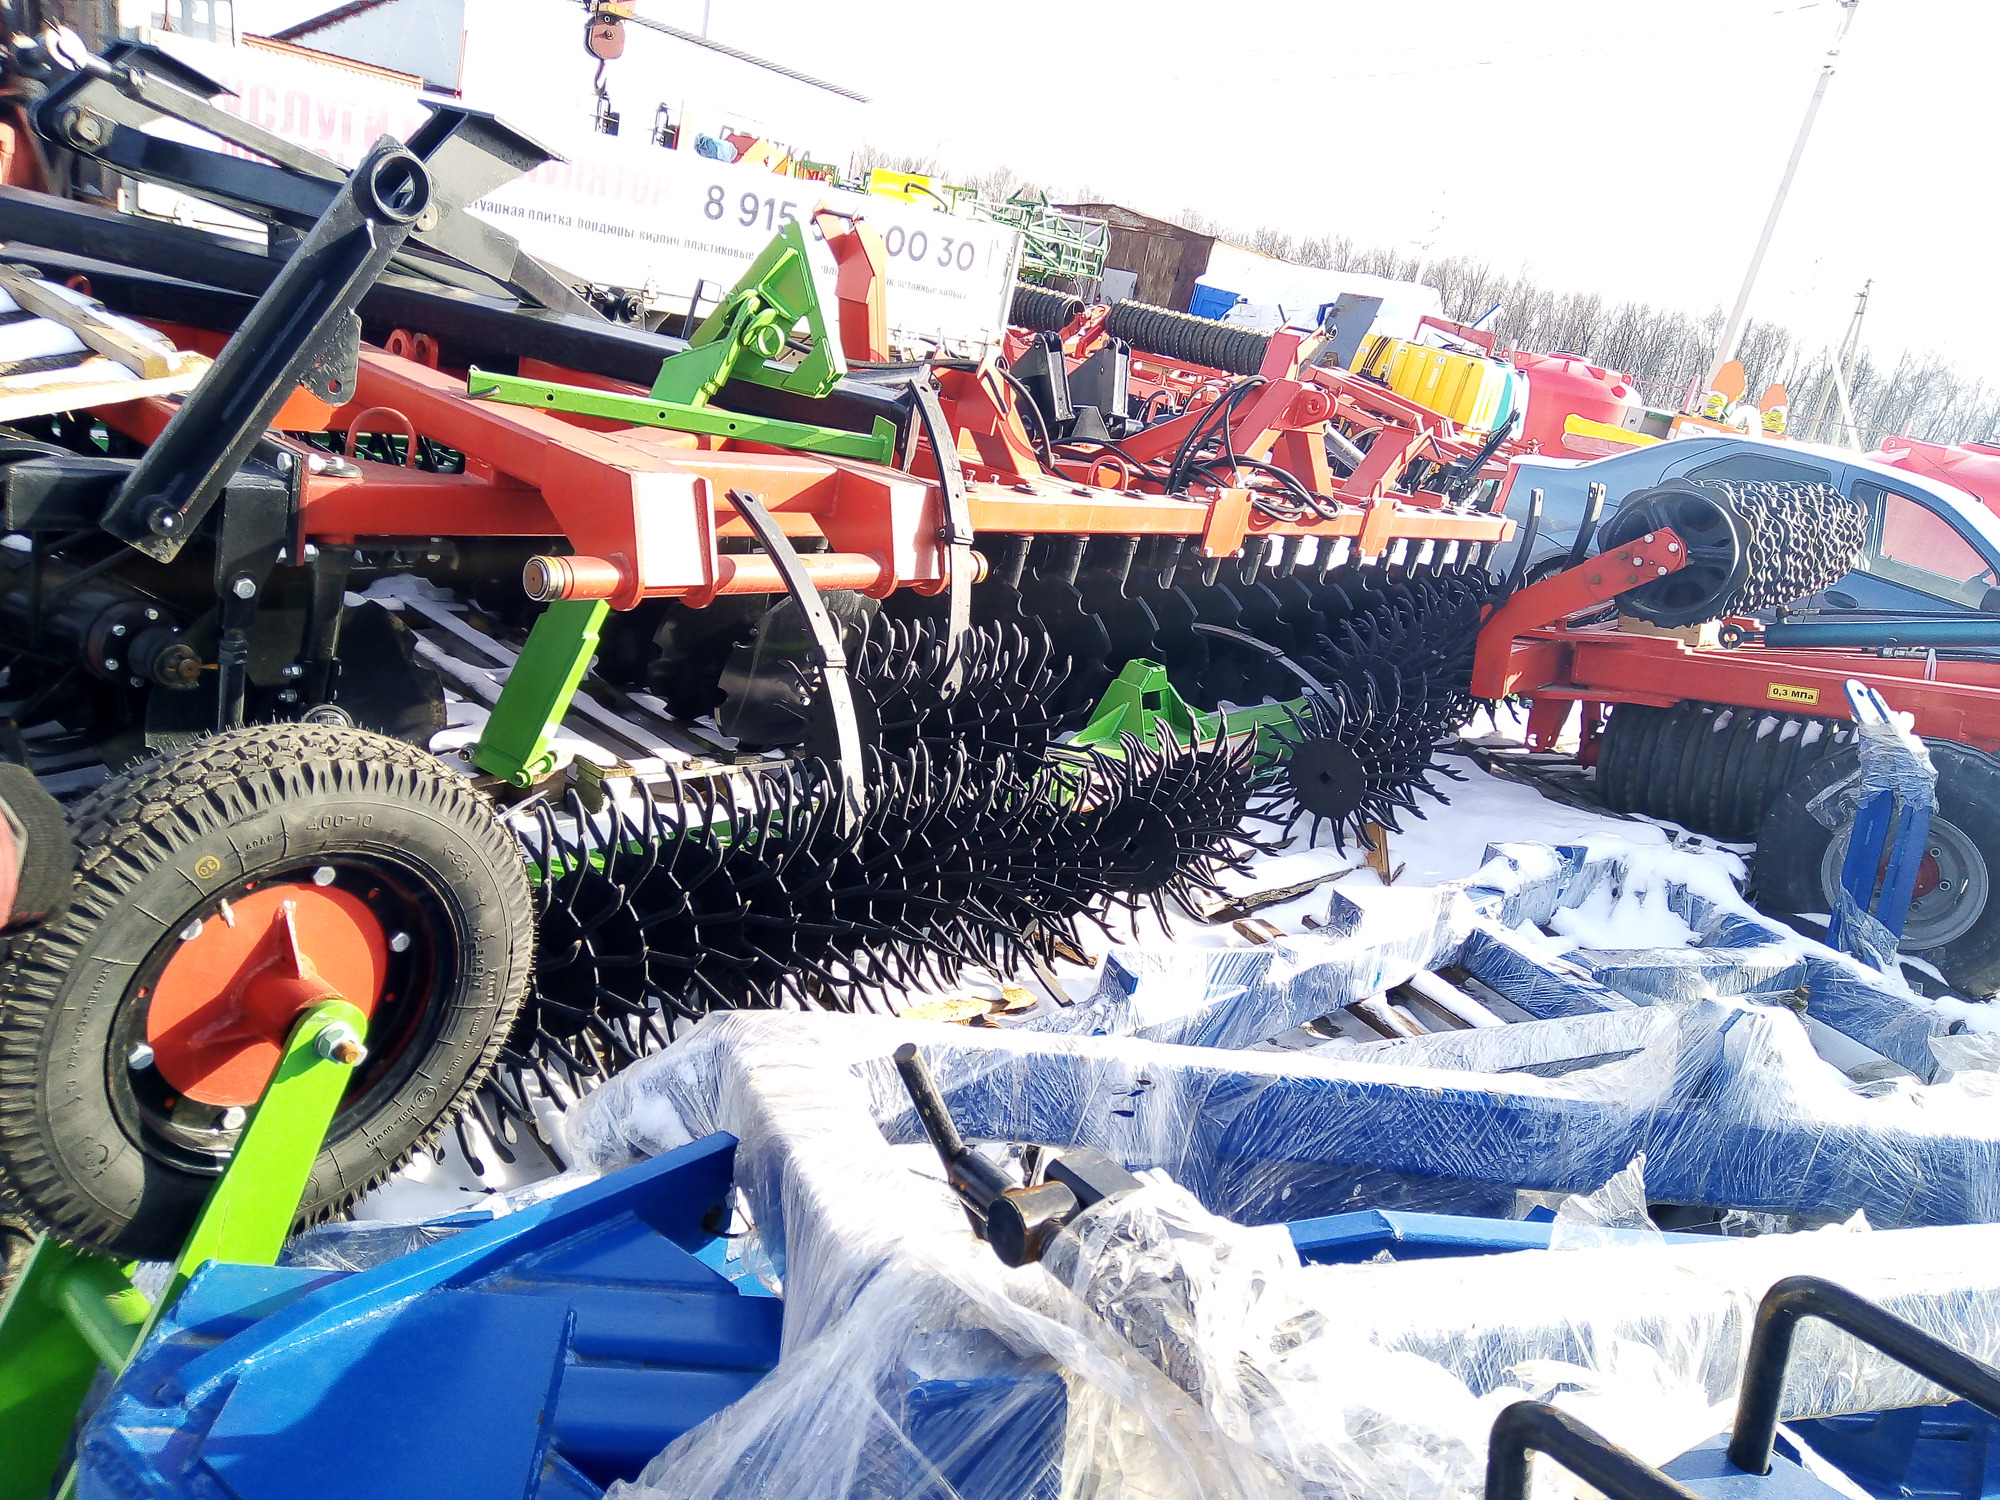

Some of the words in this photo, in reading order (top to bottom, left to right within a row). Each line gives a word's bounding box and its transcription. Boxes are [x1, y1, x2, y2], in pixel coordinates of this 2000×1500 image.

[528, 209, 572, 227] плитка
[577, 216, 635, 238] бордюры
[639, 230, 680, 247] кирпич
[683, 238, 754, 261] пластиковые
[703, 184, 725, 221] 8
[738, 191, 798, 236] 915
[885, 225, 928, 262] 00
[936, 236, 975, 271] 30
[1772, 687, 1788, 697] 0,3
[1791, 690, 1814, 700] МПа
